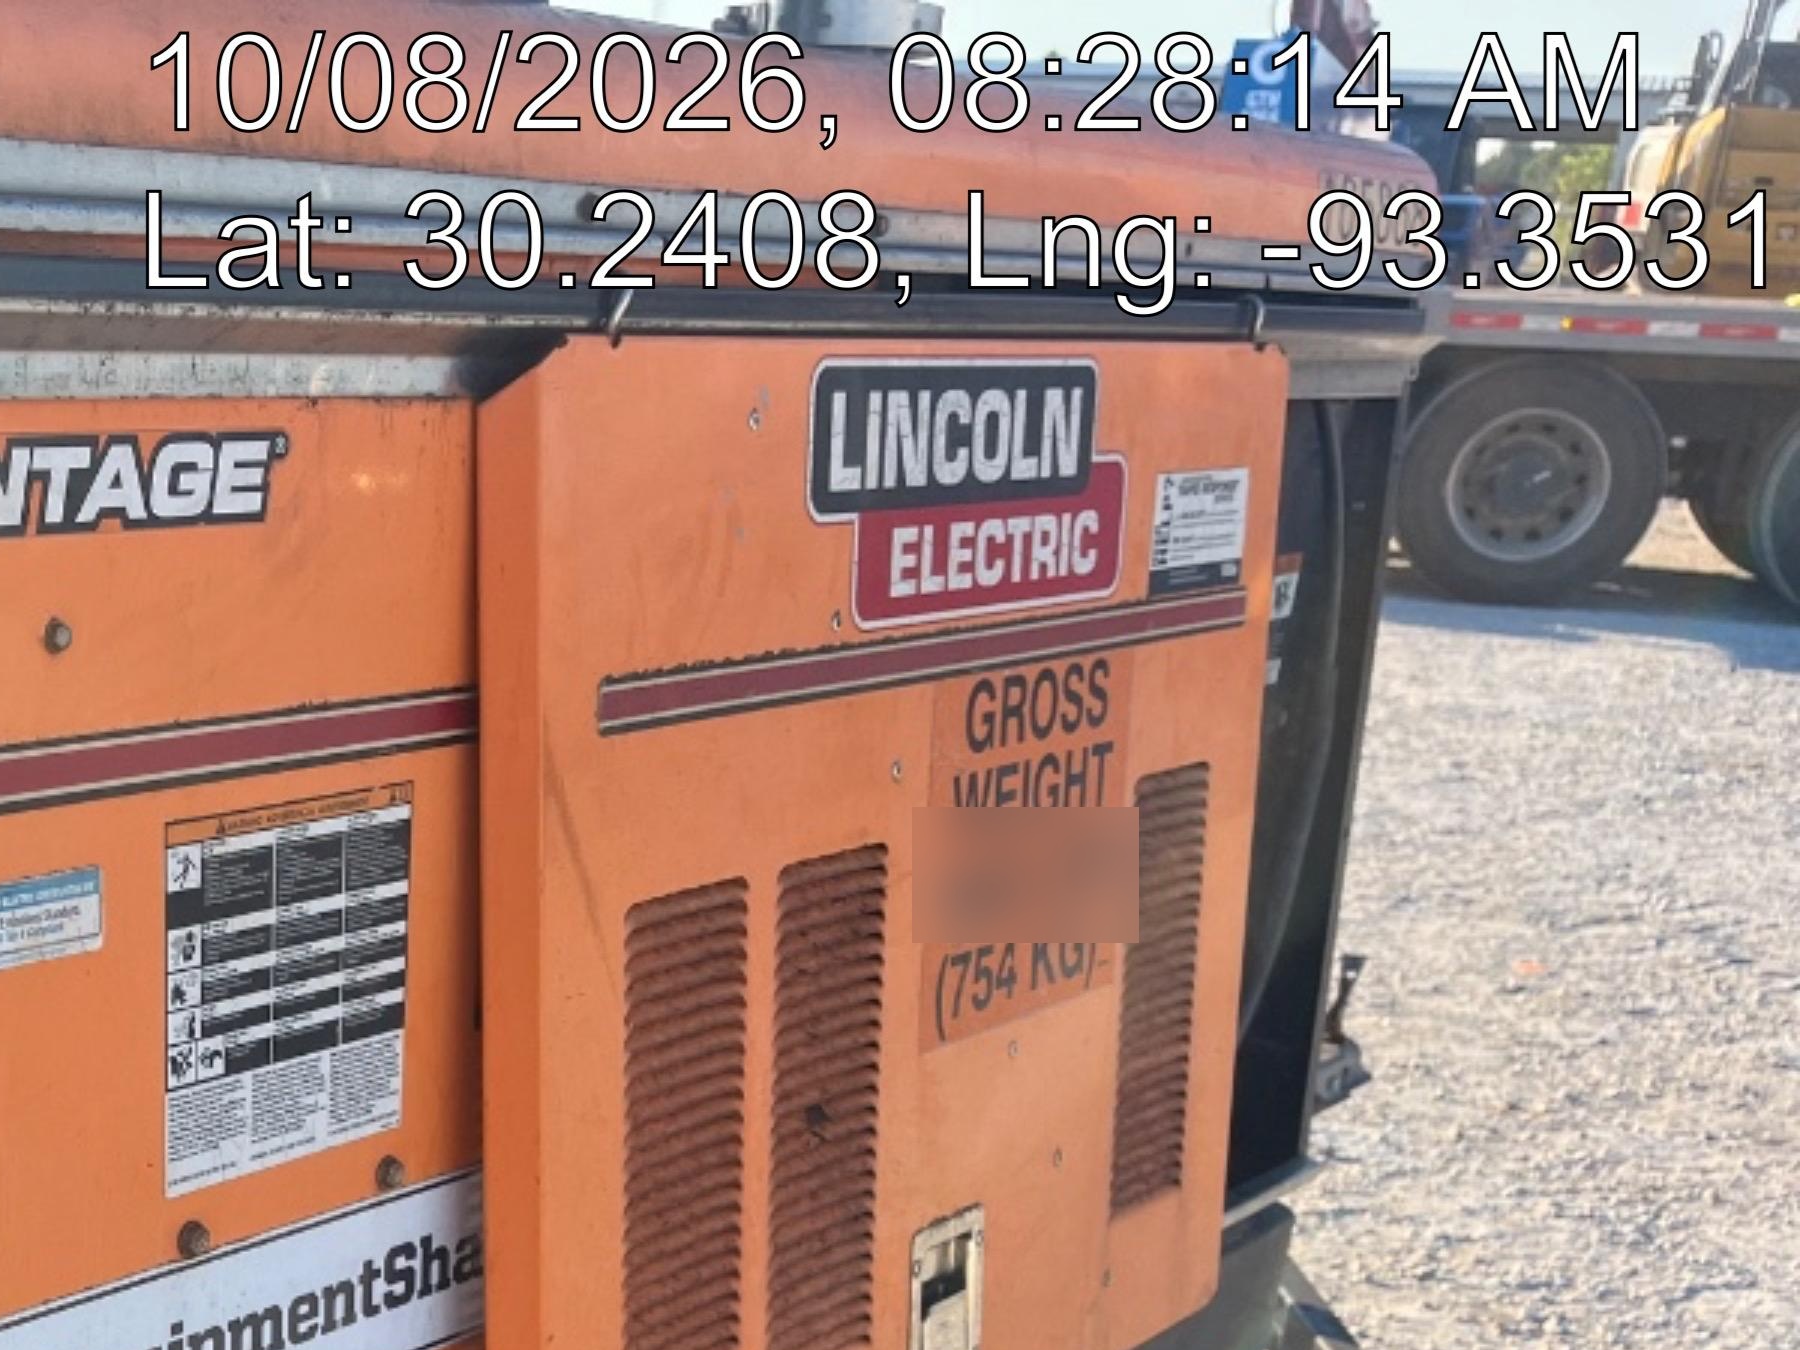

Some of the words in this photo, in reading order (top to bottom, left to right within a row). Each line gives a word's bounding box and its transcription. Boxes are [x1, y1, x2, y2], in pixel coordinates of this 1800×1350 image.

[828, 386, 1084, 493] LINCOLN
[889, 509, 1099, 598] ELECTRIC
[965, 658, 1110, 753] GROSS
